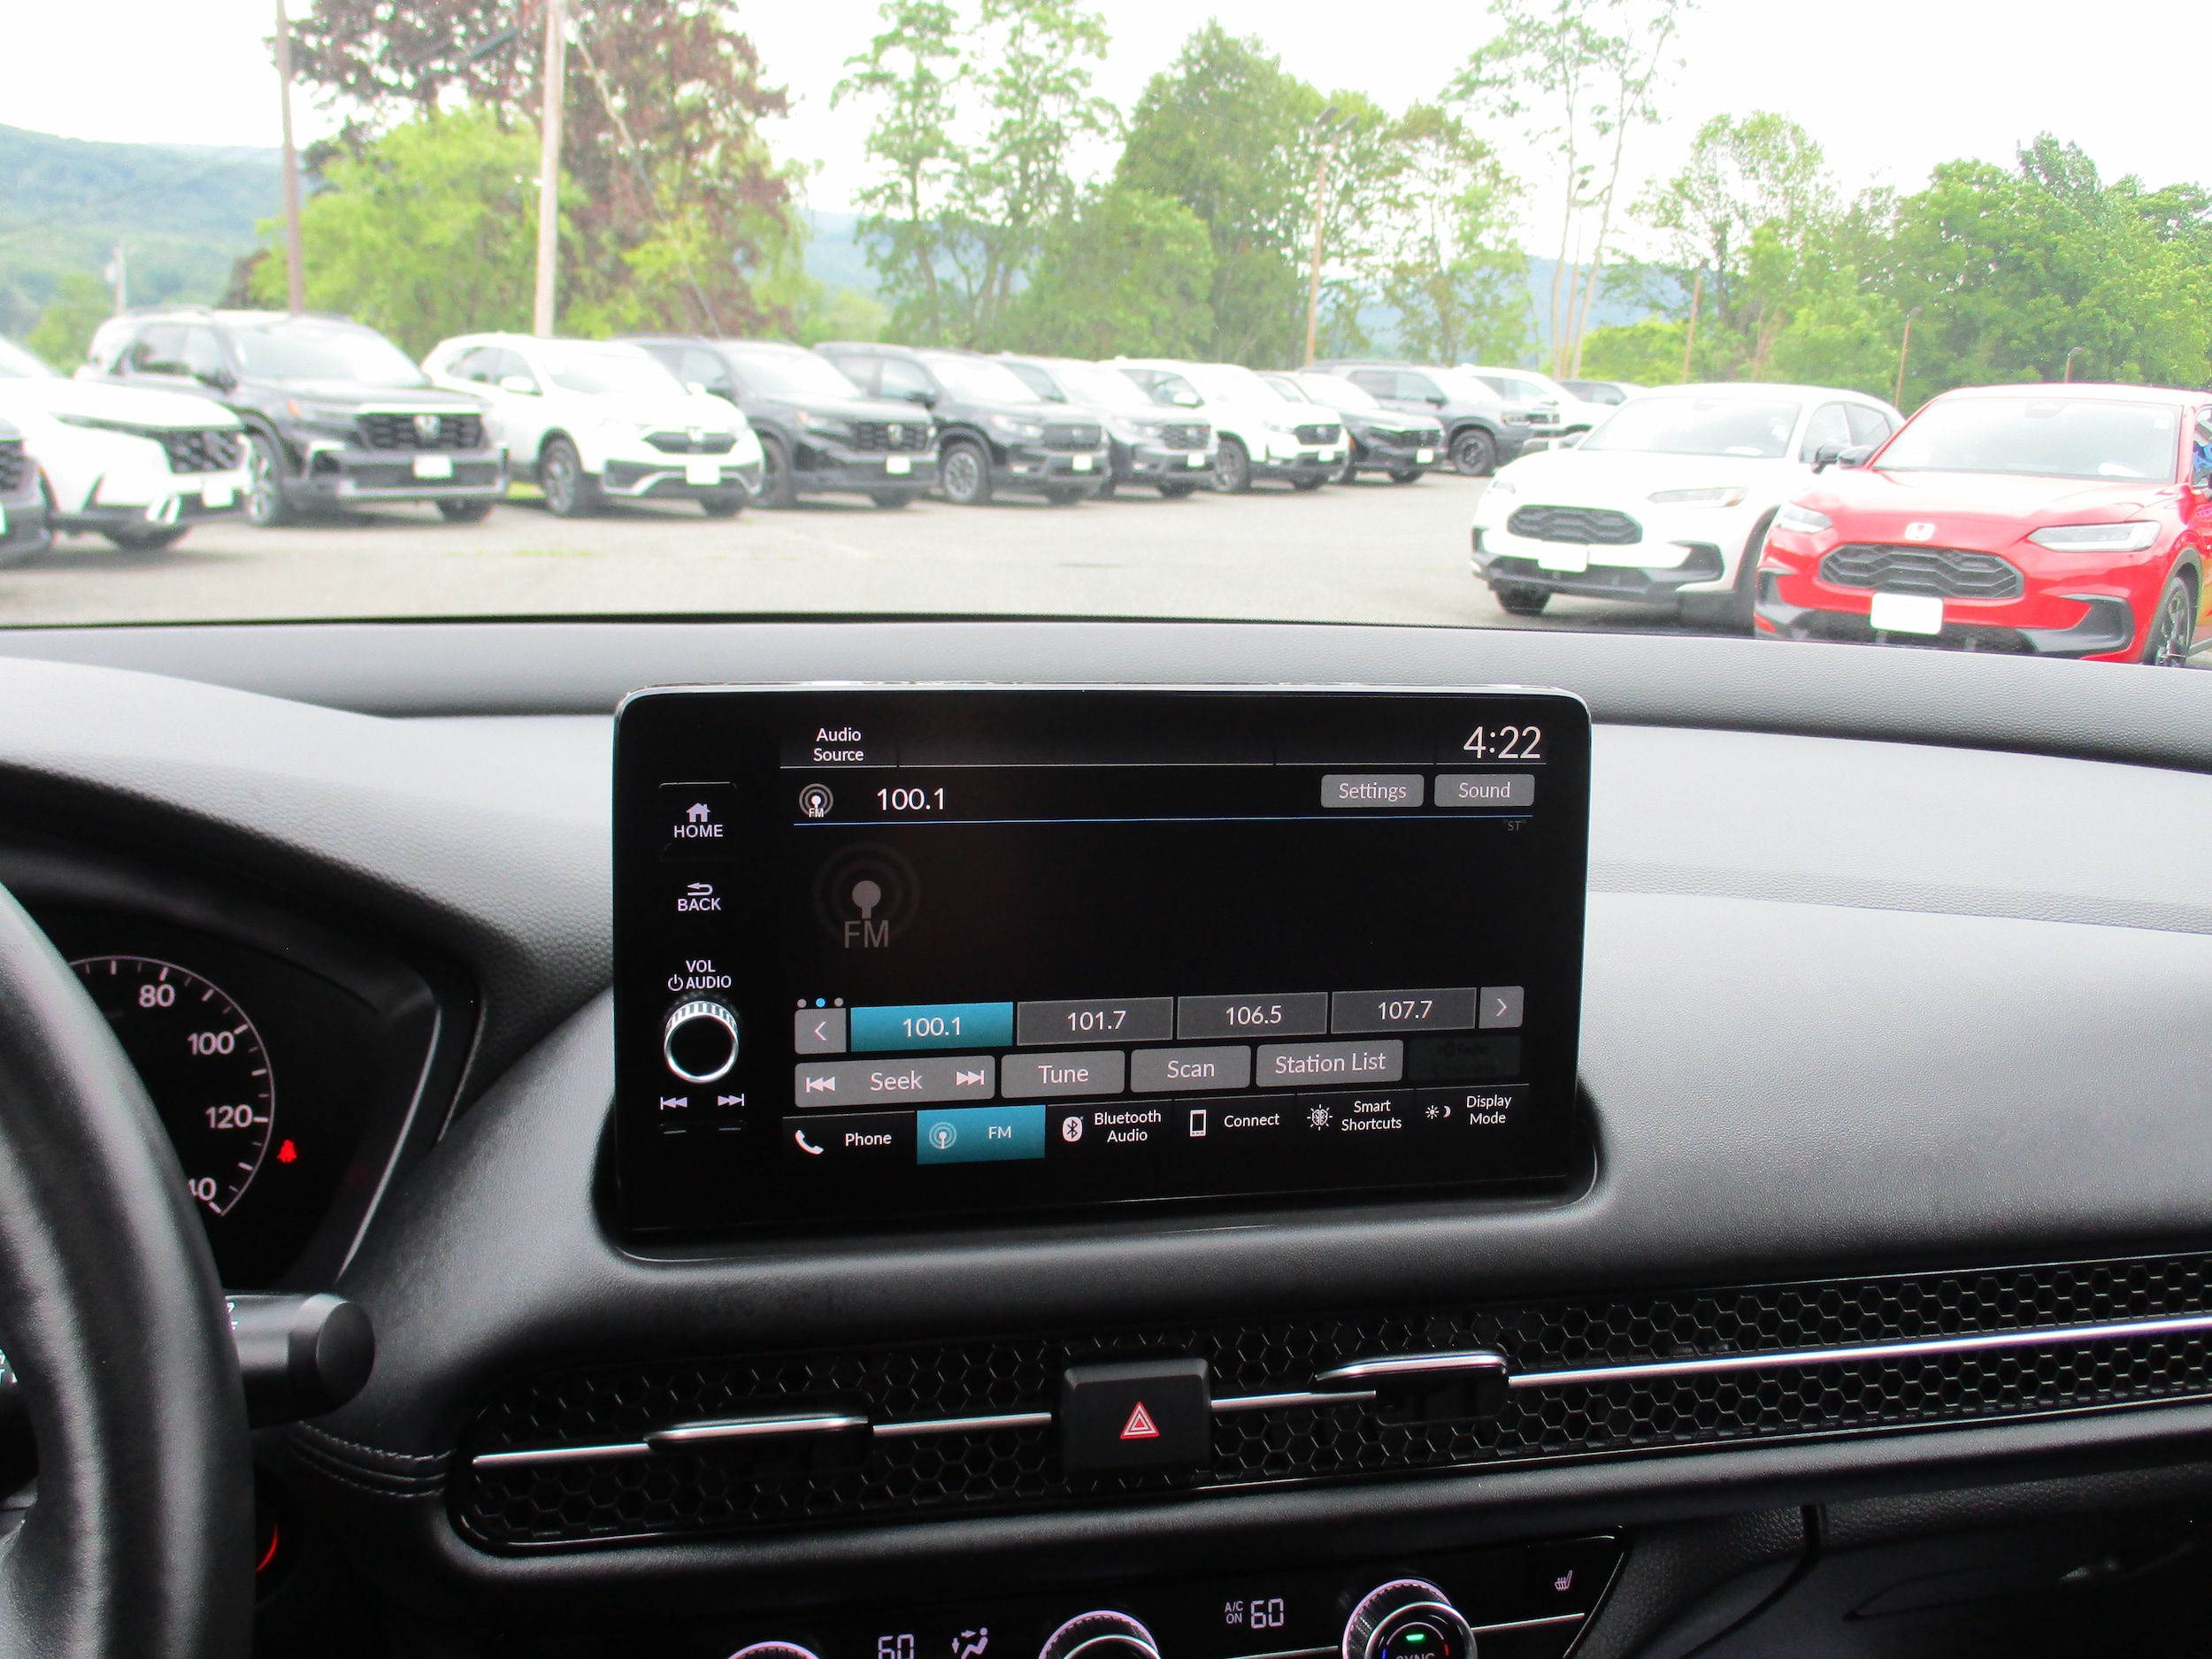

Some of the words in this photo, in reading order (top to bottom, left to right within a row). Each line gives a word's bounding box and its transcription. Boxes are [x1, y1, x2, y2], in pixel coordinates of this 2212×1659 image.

[816, 726, 862, 742] Audio
[1463, 726, 1542, 759] 4:22
[813, 748, 864, 763] Source
[1338, 780, 1408, 803] Settings
[1458, 780, 1511, 799] Sound
[876, 787, 945, 811] 100.1
[808, 808, 825, 818] FM
[673, 824, 724, 839] HOME
[677, 897, 722, 912] BACK
[843, 919, 890, 949] FM
[685, 959, 716, 974] VOL
[686, 975, 733, 990] AUDIO
[137, 984, 176, 1009] 80
[1225, 1004, 1283, 1026] 106.5
[1377, 999, 1433, 1021] 107.7
[902, 1016, 963, 1038] 100.1
[1066, 1010, 1127, 1033] 101.7
[187, 1030, 236, 1056] 100
[1166, 1059, 1216, 1079] Scan
[1274, 1053, 1346, 1075] Station
[1352, 1050, 1387, 1071] List
[870, 1071, 923, 1092] Seek
[1037, 1064, 1090, 1085] Tune
[1353, 1099, 1392, 1114] Smart
[1466, 1094, 1513, 1111] Display
[204, 1103, 253, 1130] 120
[1094, 1108, 1163, 1126] Bluetooth
[1224, 1112, 1281, 1128] Connect
[1340, 1117, 1403, 1133] Shortcuts
[1469, 1110, 1507, 1126] Mode
[844, 1131, 893, 1148] Phone
[987, 1125, 1012, 1141] FM
[1106, 1128, 1148, 1144] Audio
[1224, 1600, 1244, 1613] A/C
[1250, 1597, 1285, 1629] 60
[1225, 1612, 1243, 1624] ON
